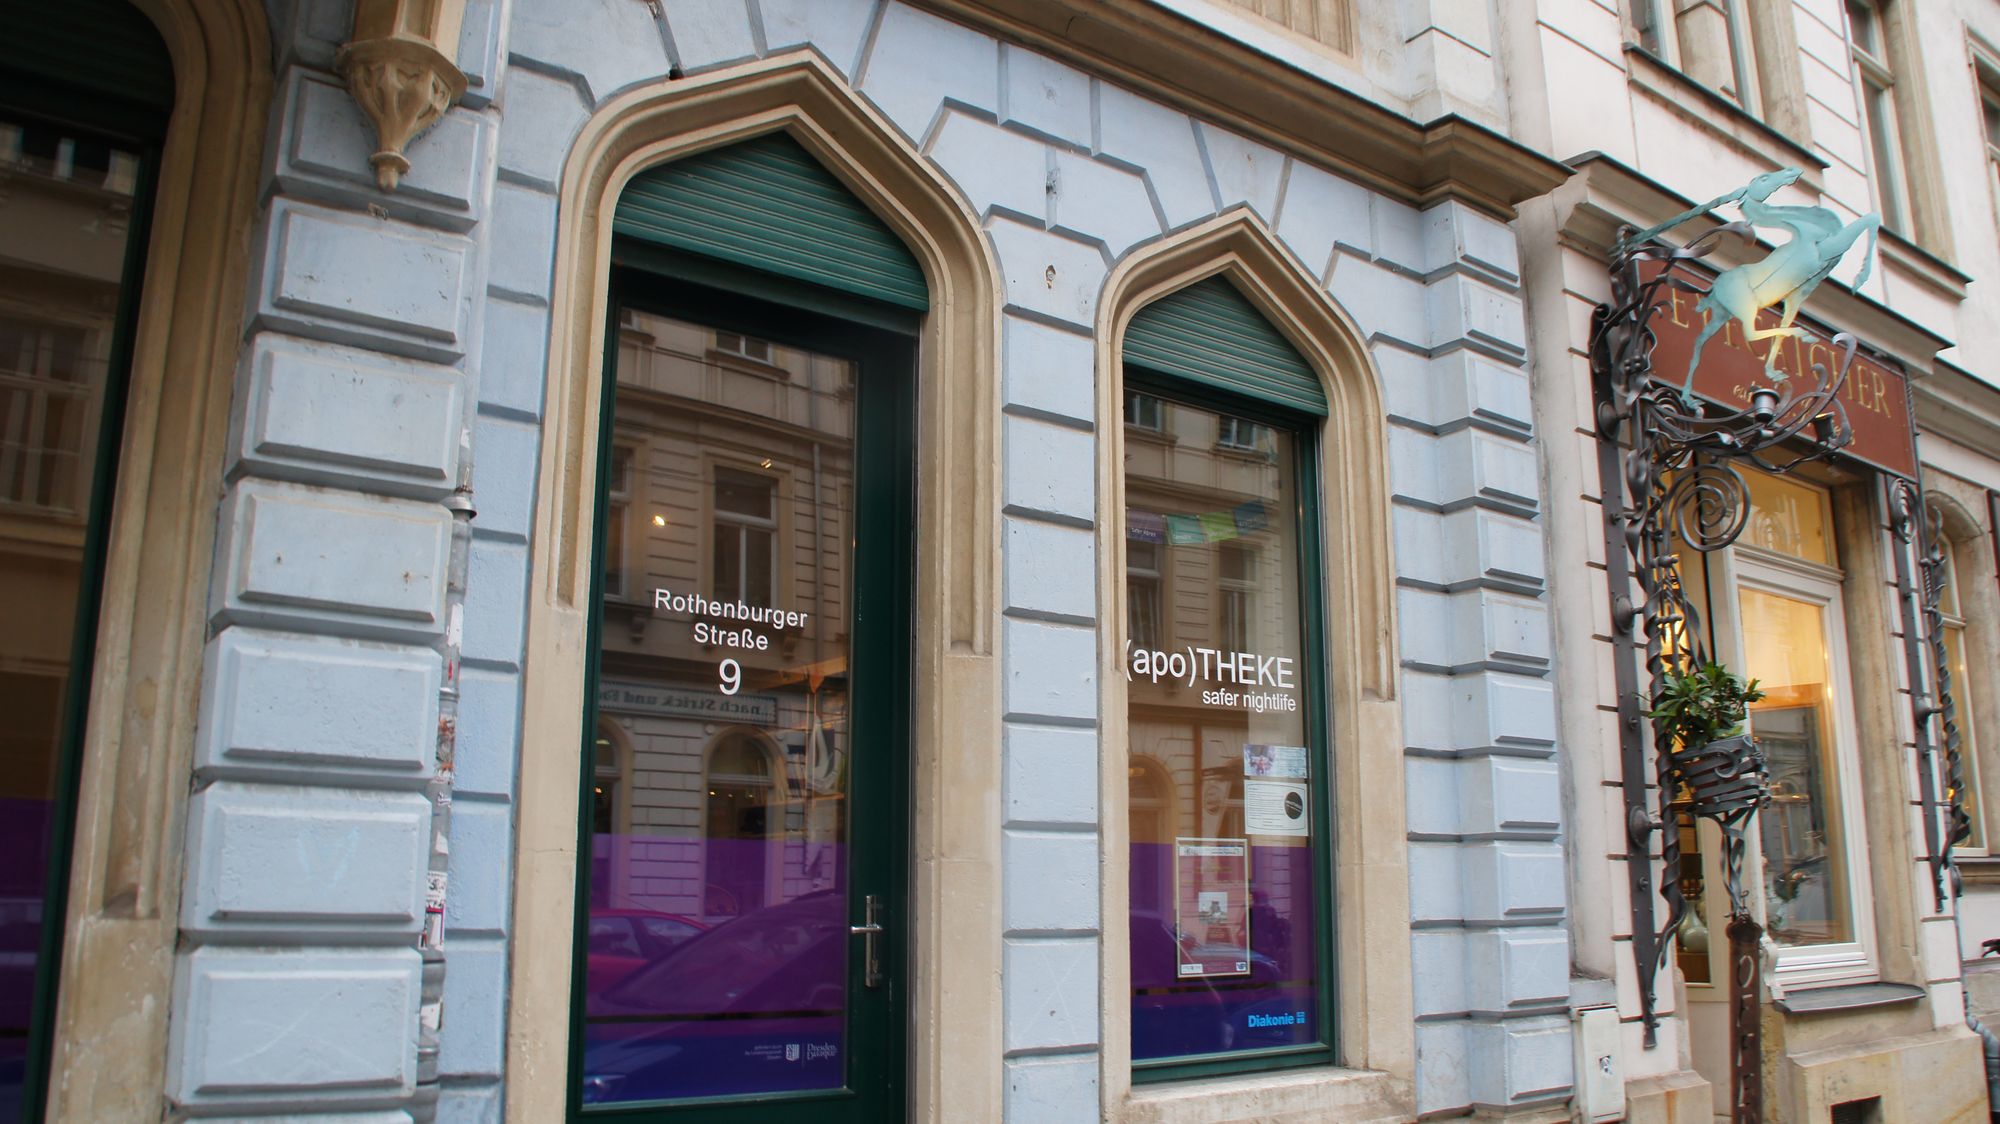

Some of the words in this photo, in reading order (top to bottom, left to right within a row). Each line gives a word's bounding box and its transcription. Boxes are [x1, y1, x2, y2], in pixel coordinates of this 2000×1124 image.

[655, 588, 808, 630] Rothenburger
[694, 622, 769, 650] Straße
[719, 658, 741, 695] 9
[1126, 640, 1295, 689] (apo)THEKE
[1202, 687, 1240, 707] safer
[1243, 691, 1296, 713] nightlife
[1248, 1012, 1295, 1028] Diakonie
[1736, 954, 1756, 1124] OFFE
